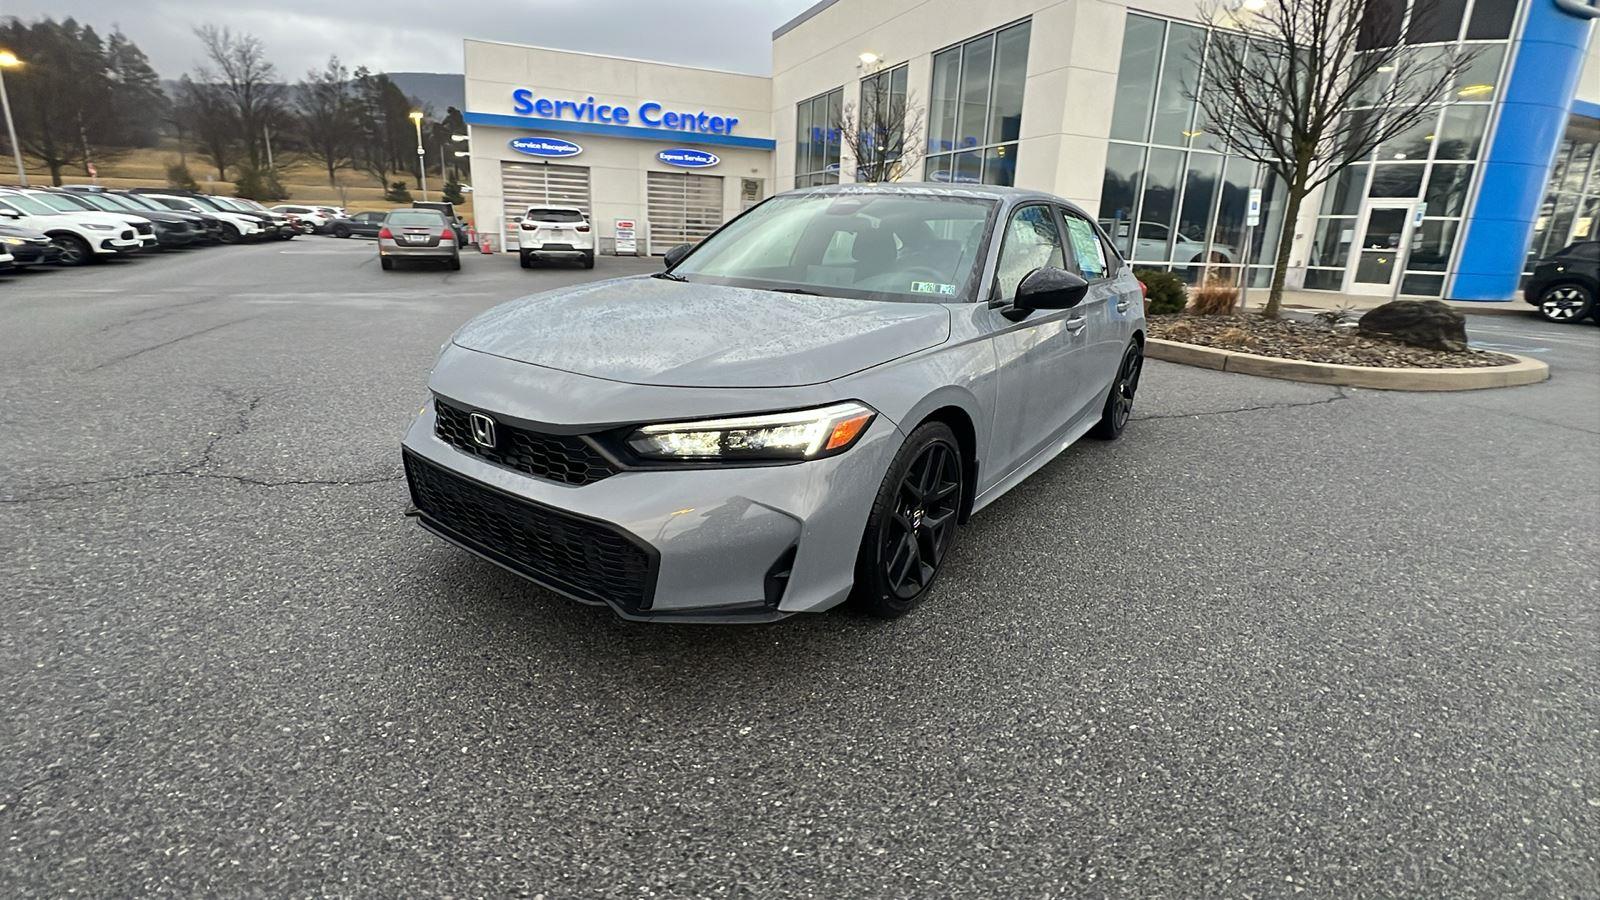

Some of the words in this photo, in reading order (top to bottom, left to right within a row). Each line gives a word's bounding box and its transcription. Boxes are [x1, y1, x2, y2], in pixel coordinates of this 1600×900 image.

[513, 88, 630, 125] Service
[639, 102, 738, 135] Center
[513, 140, 540, 149] Service
[541, 143, 578, 152] Reception
[659, 153, 683, 161] Express
[684, 154, 706, 162] Service
